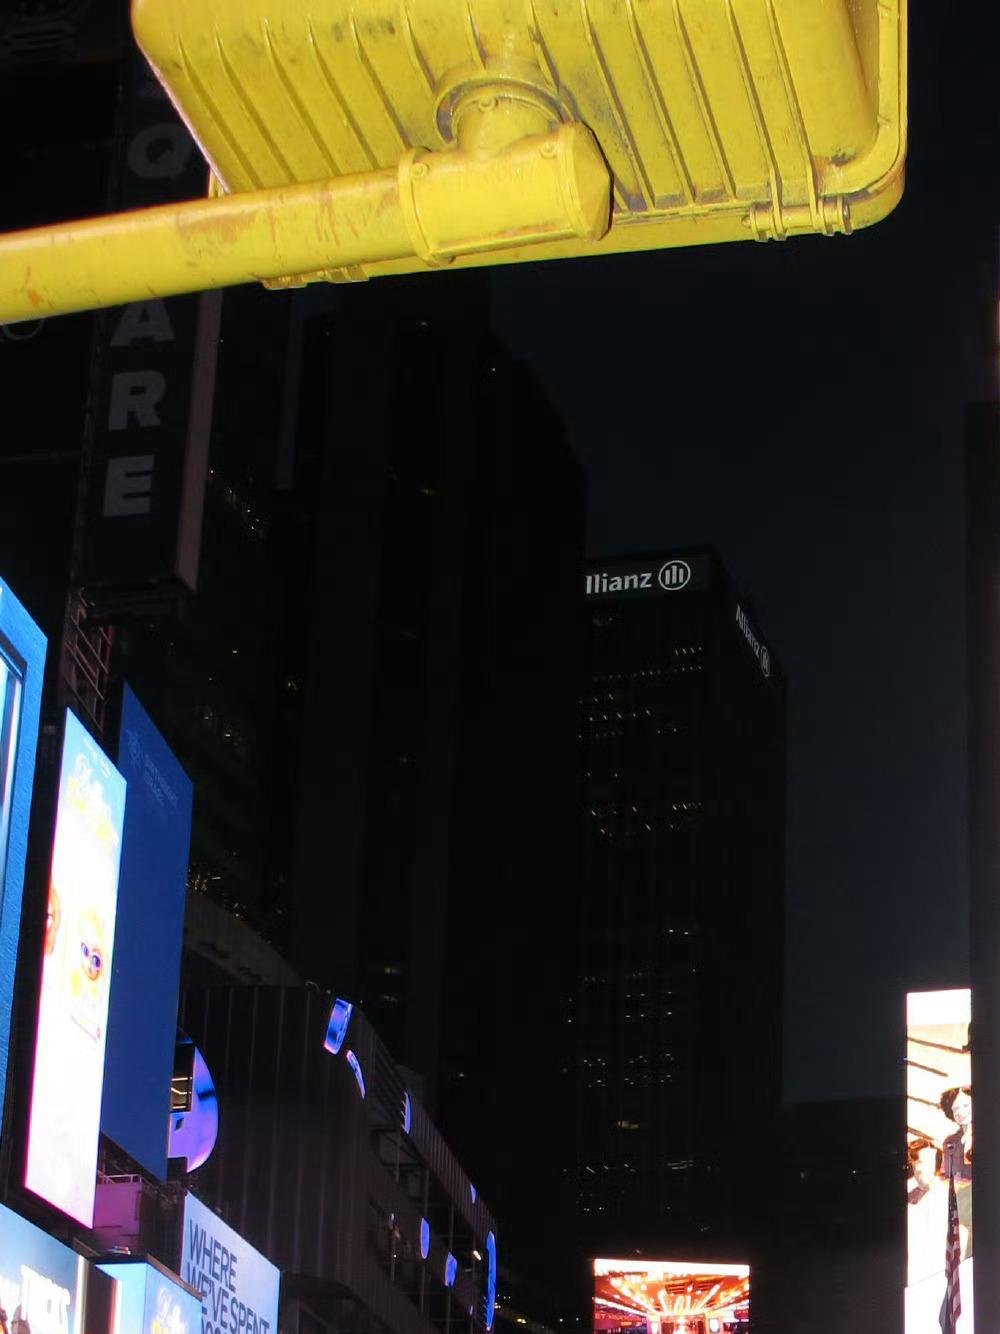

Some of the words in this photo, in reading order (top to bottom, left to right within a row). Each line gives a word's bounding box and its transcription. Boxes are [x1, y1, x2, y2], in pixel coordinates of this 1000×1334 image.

[585, 572, 653, 594] llianz
[189, 1219, 238, 1293] WHERE
[187, 1262, 229, 1329] WE'VE
